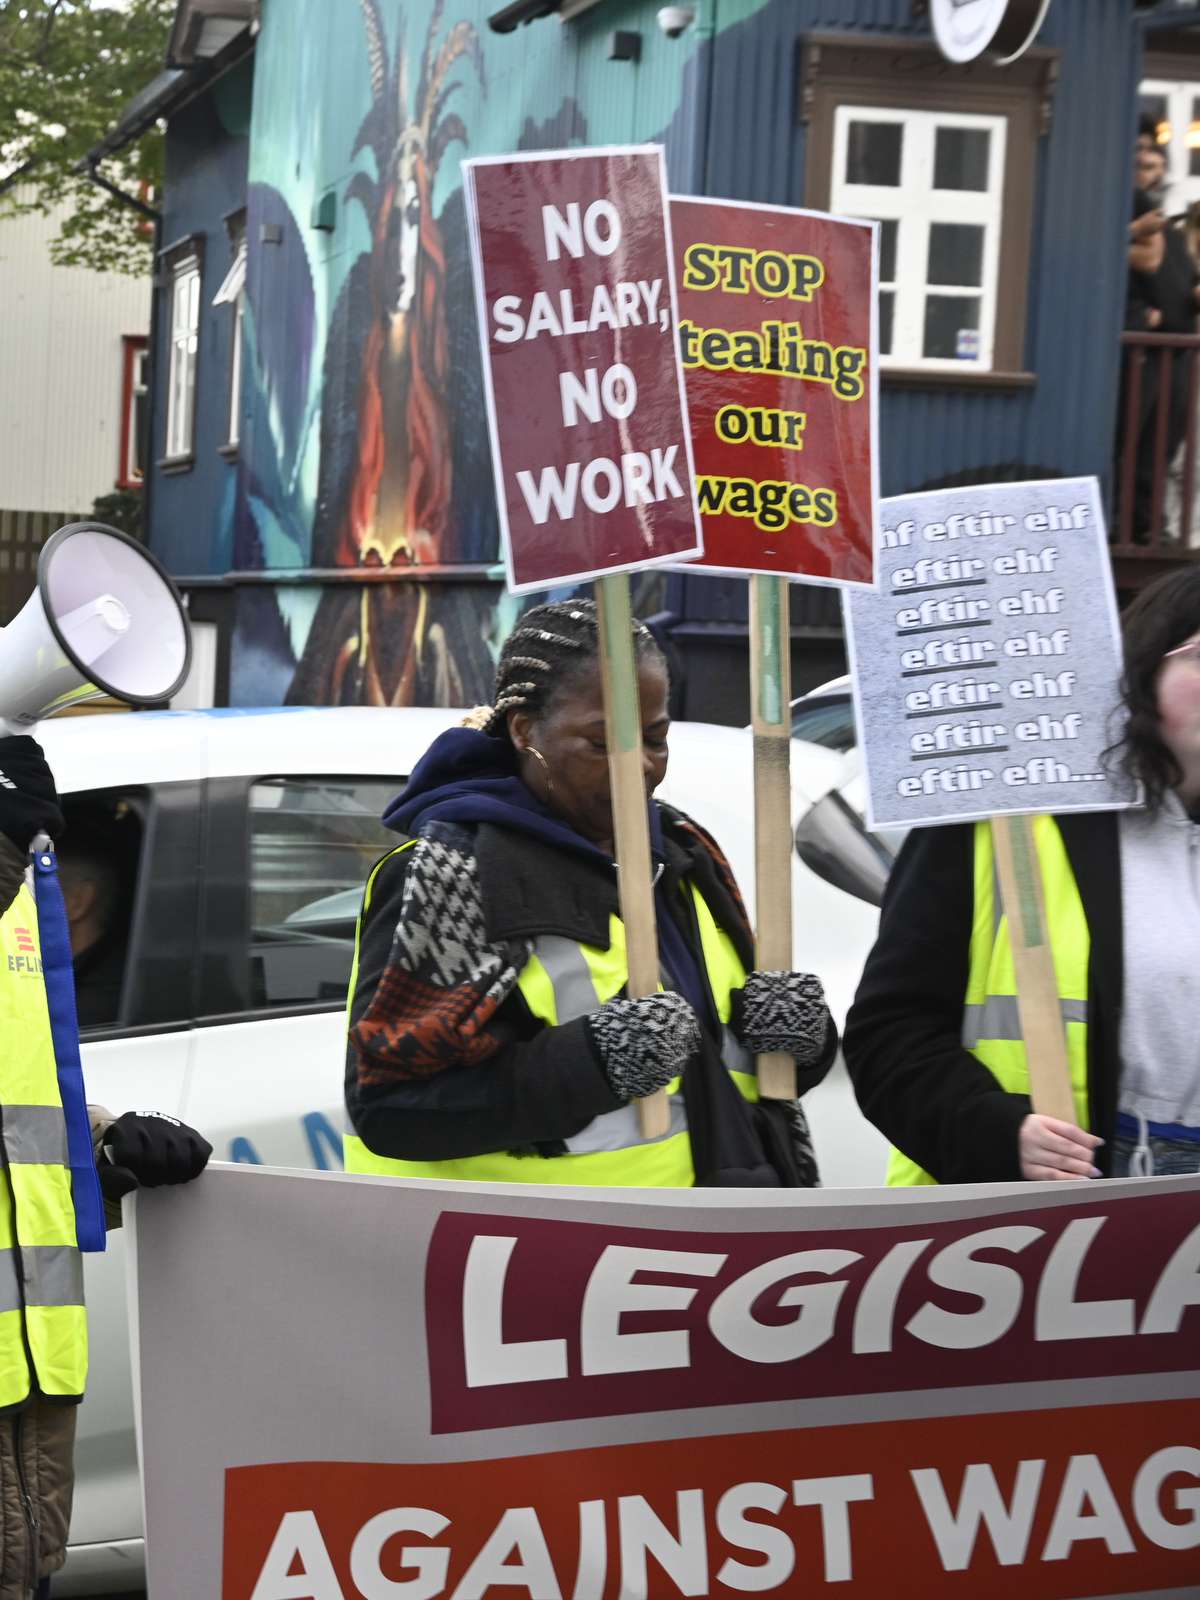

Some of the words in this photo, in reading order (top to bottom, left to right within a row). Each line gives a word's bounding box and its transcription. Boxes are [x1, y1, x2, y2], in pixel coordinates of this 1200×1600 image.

[541, 199, 622, 262] NO
[685, 245, 823, 300] STOP
[492, 278, 670, 344] SALARY,
[559, 363, 638, 428] NO
[718, 406, 804, 447] our
[515, 444, 685, 525] WORK
[922, 511, 1017, 544] eftir
[1023, 504, 1090, 533] ehf
[891, 554, 985, 589] eftir
[993, 546, 1060, 577] ehf
[896, 595, 990, 629] eftir
[998, 588, 1065, 618] ehf
[900, 636, 995, 671] eftir
[1003, 629, 1071, 659] ehf
[904, 677, 1002, 712] eftir
[1008, 671, 1076, 701] ehf
[910, 719, 1008, 754] eftir
[1014, 712, 1083, 743] ehf
[897, 764, 995, 799] eftir
[248, 1472, 875, 1600] AGAINST
